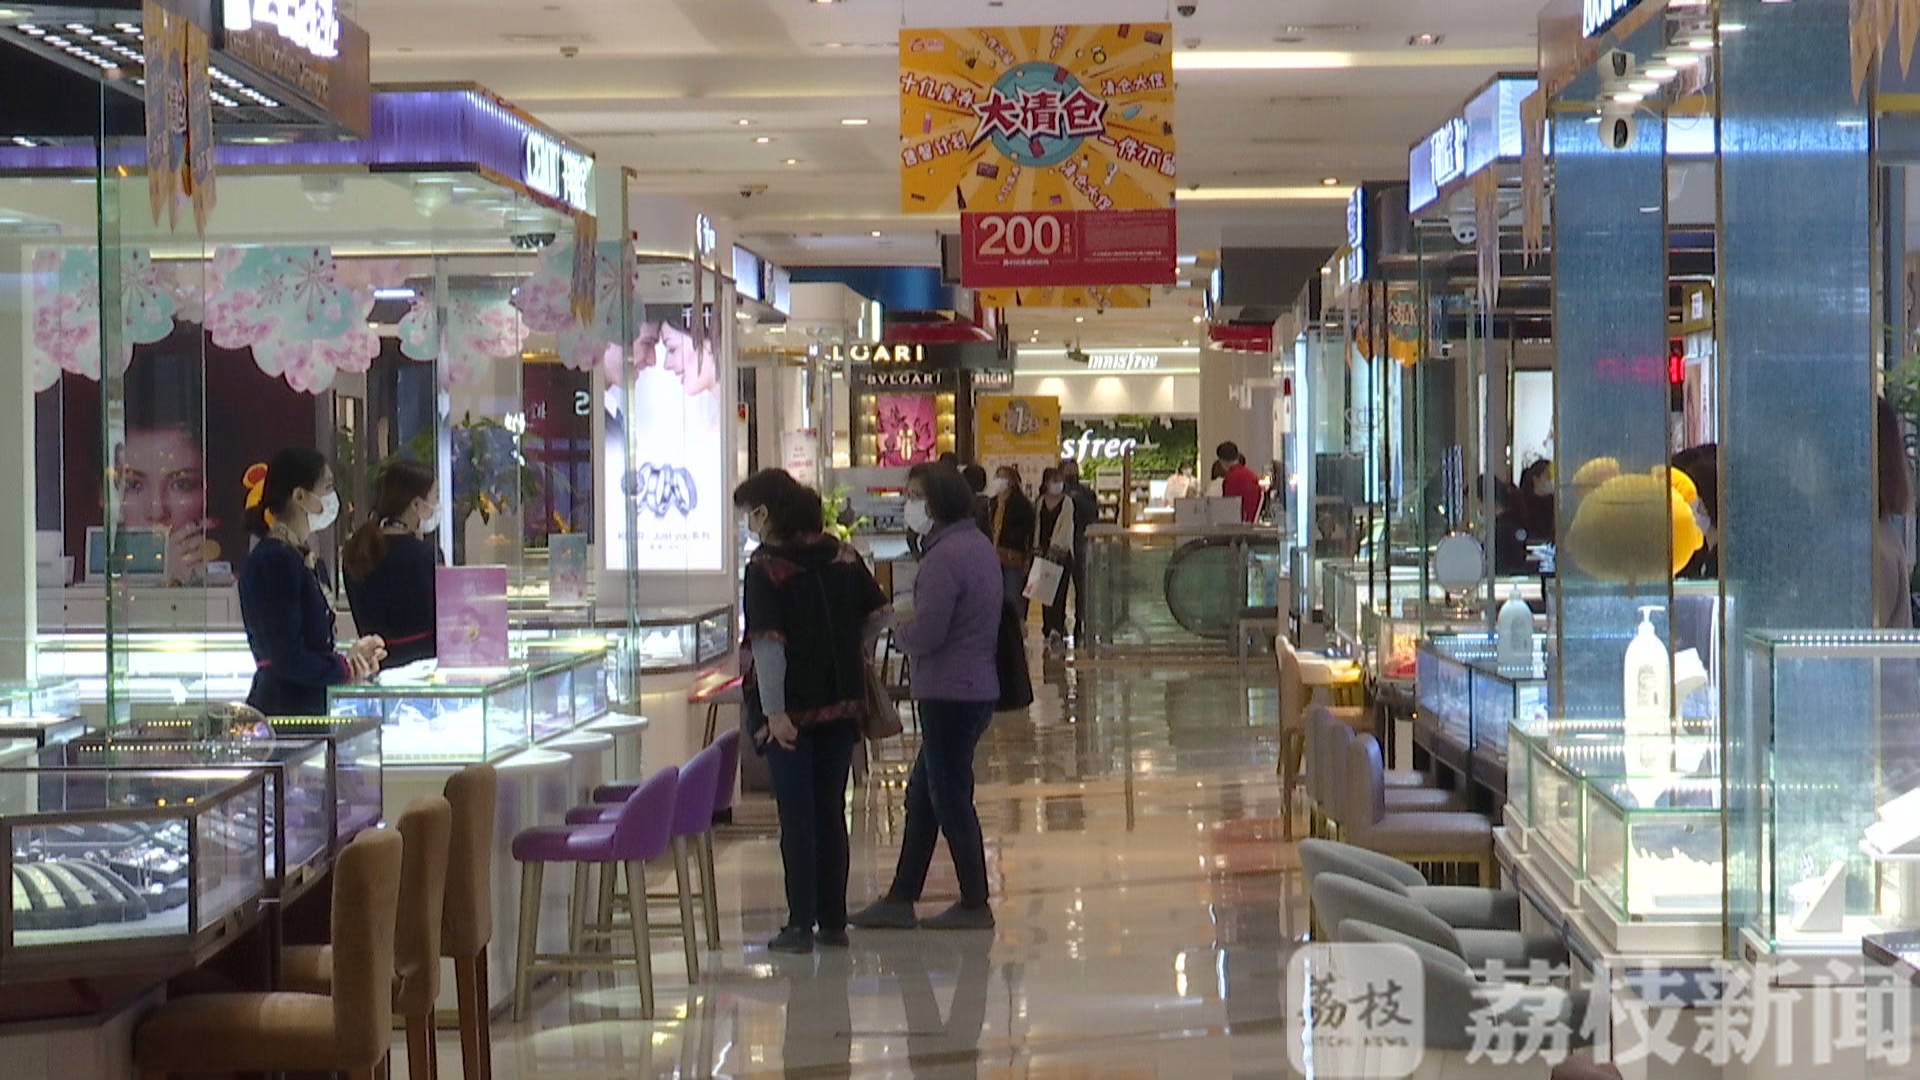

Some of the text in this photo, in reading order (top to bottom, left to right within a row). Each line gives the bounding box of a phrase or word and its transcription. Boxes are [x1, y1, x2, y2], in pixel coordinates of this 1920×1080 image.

[975, 88, 1105, 136] 大清仓
[979, 216, 1060, 255] 200
[867, 373, 941, 385] BVLGARI
